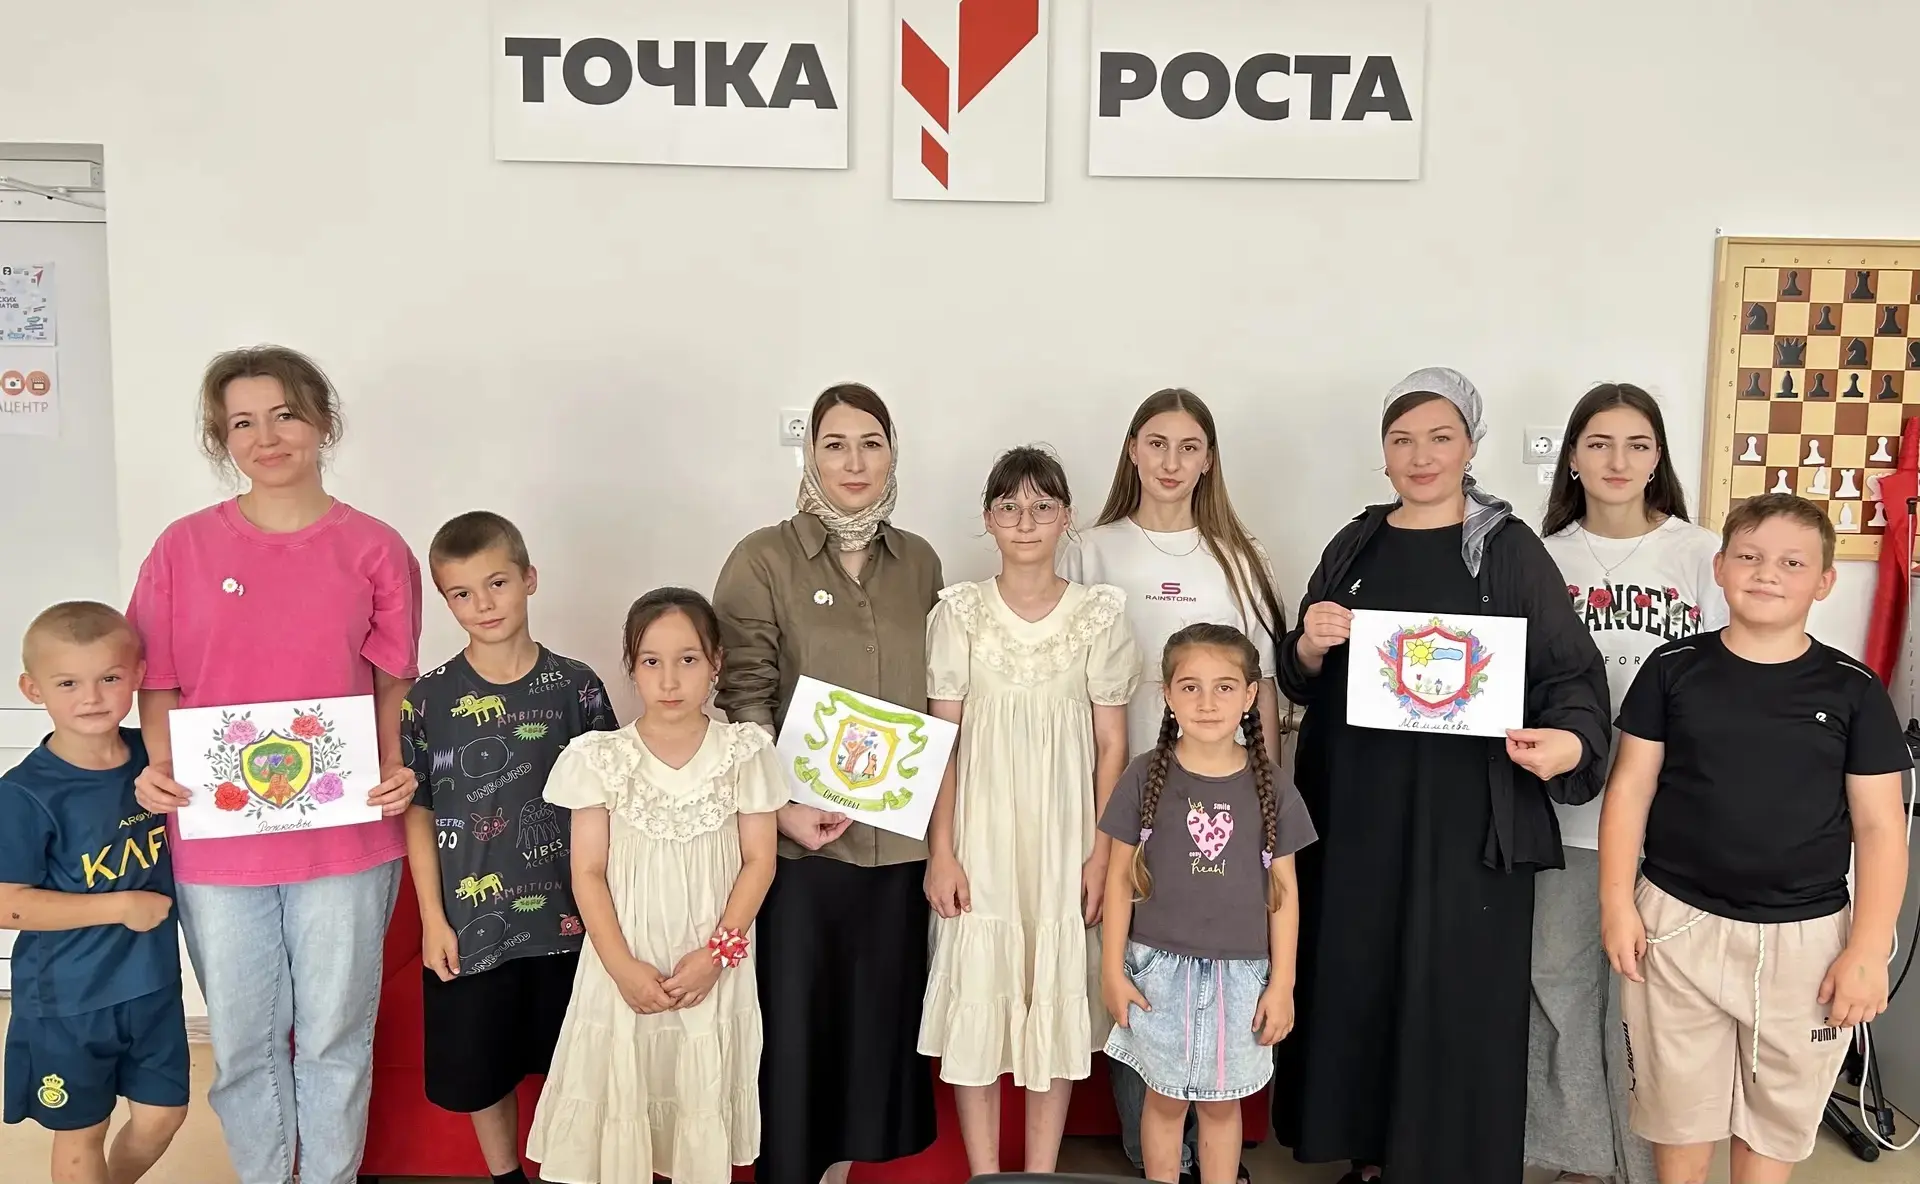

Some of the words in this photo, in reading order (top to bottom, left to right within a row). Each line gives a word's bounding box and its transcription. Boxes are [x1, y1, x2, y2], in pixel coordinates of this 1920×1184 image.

[505, 37, 838, 110] ТОЧКА
[1099, 51, 1412, 122] РОСТА
[1145, 594, 1197, 602] RAINSTORM
[497, 709, 563, 728] AMBITION
[466, 762, 532, 803] UNBOUND
[81, 825, 170, 888] KAF
[1191, 858, 1226, 876] heart
[494, 881, 562, 905] AMBITION
[1810, 1026, 1837, 1042] PUMA
